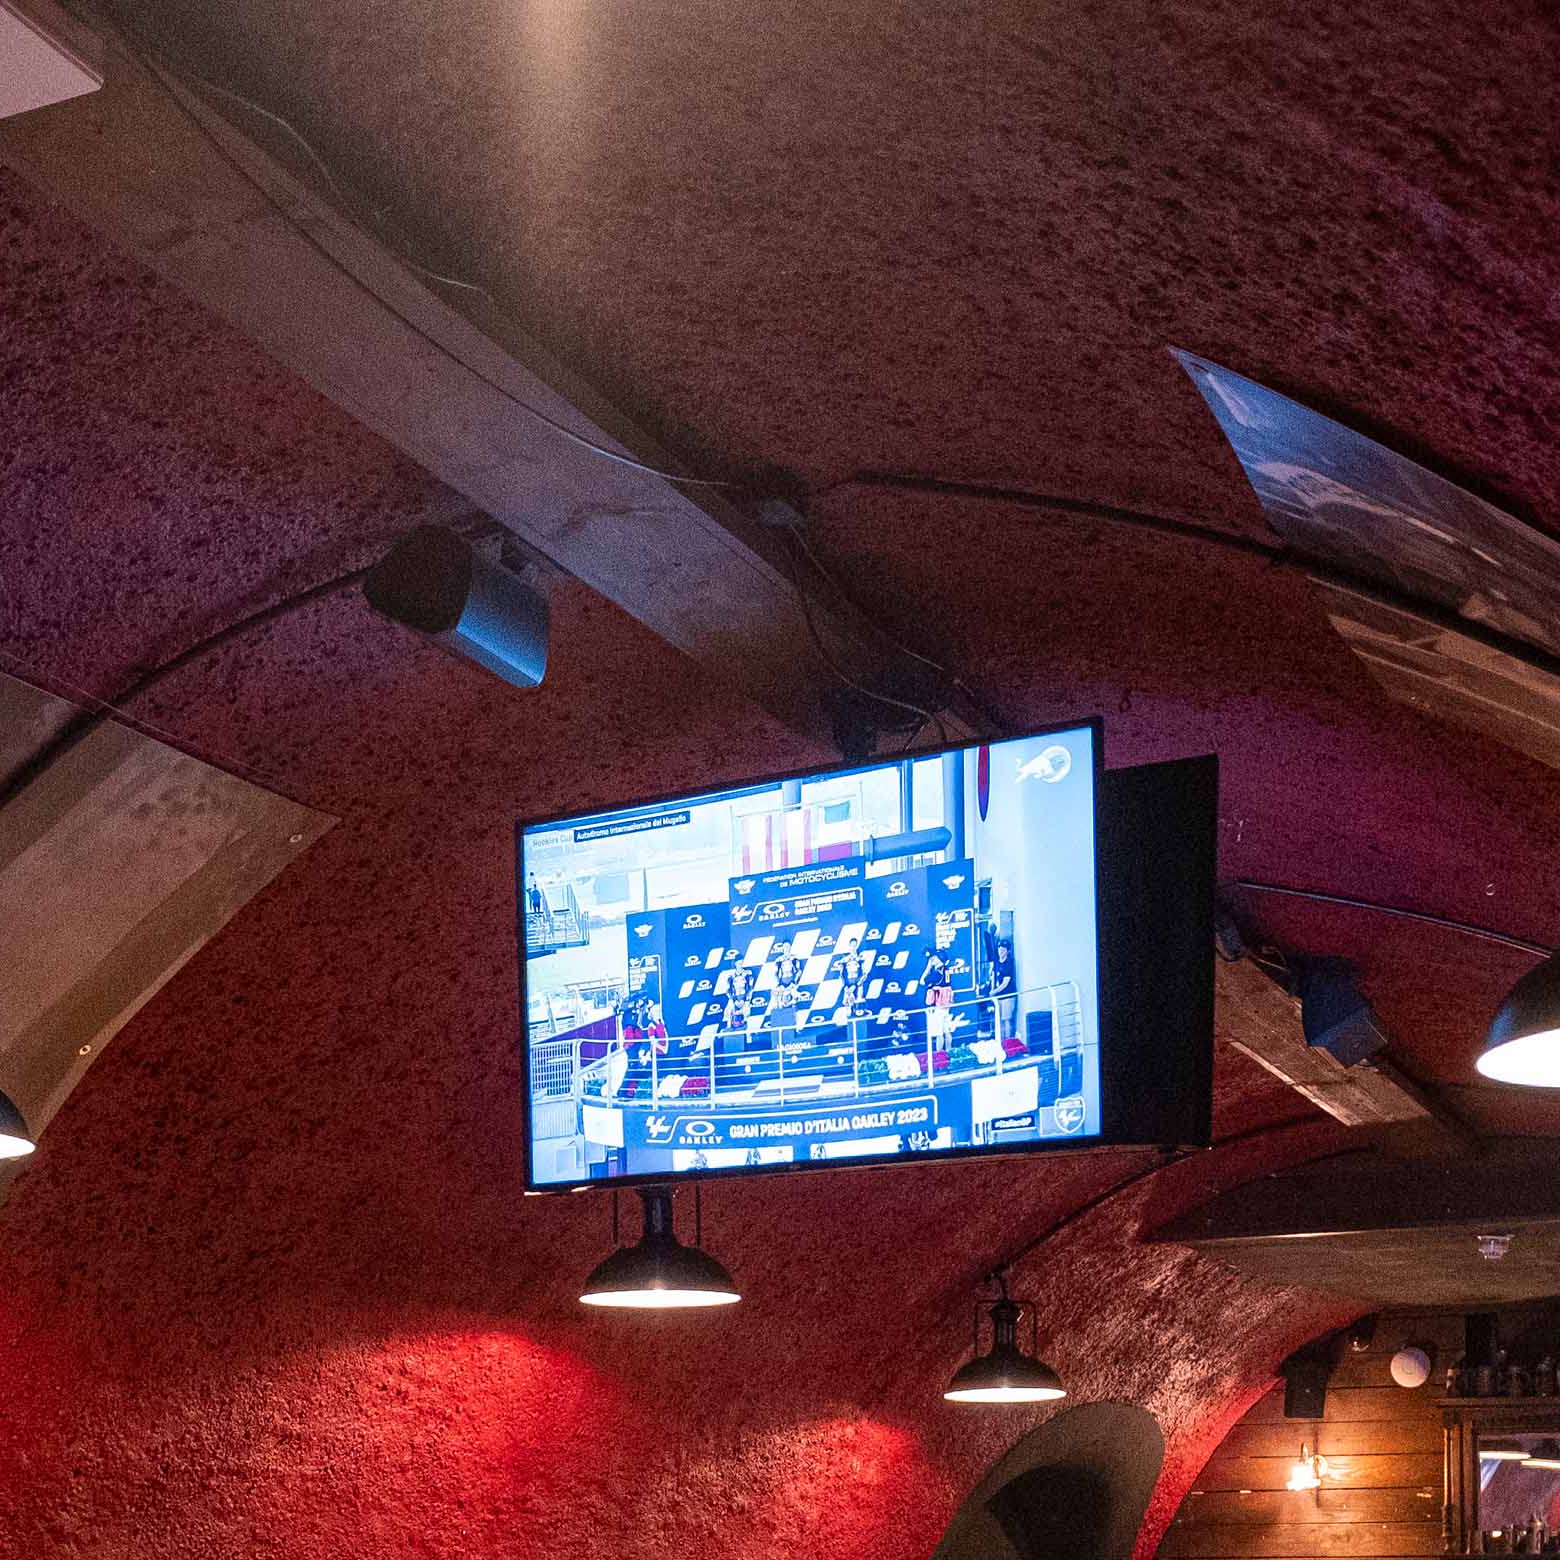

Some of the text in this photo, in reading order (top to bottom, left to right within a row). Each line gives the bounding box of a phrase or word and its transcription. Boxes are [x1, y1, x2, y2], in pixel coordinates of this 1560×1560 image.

[789, 867, 859, 886] MOTOCYCLISME
[729, 1107, 929, 1138] GRAN PREMIO D'ITALIA OAKLEY 2023
[679, 1135, 724, 1145] OAKLEY
